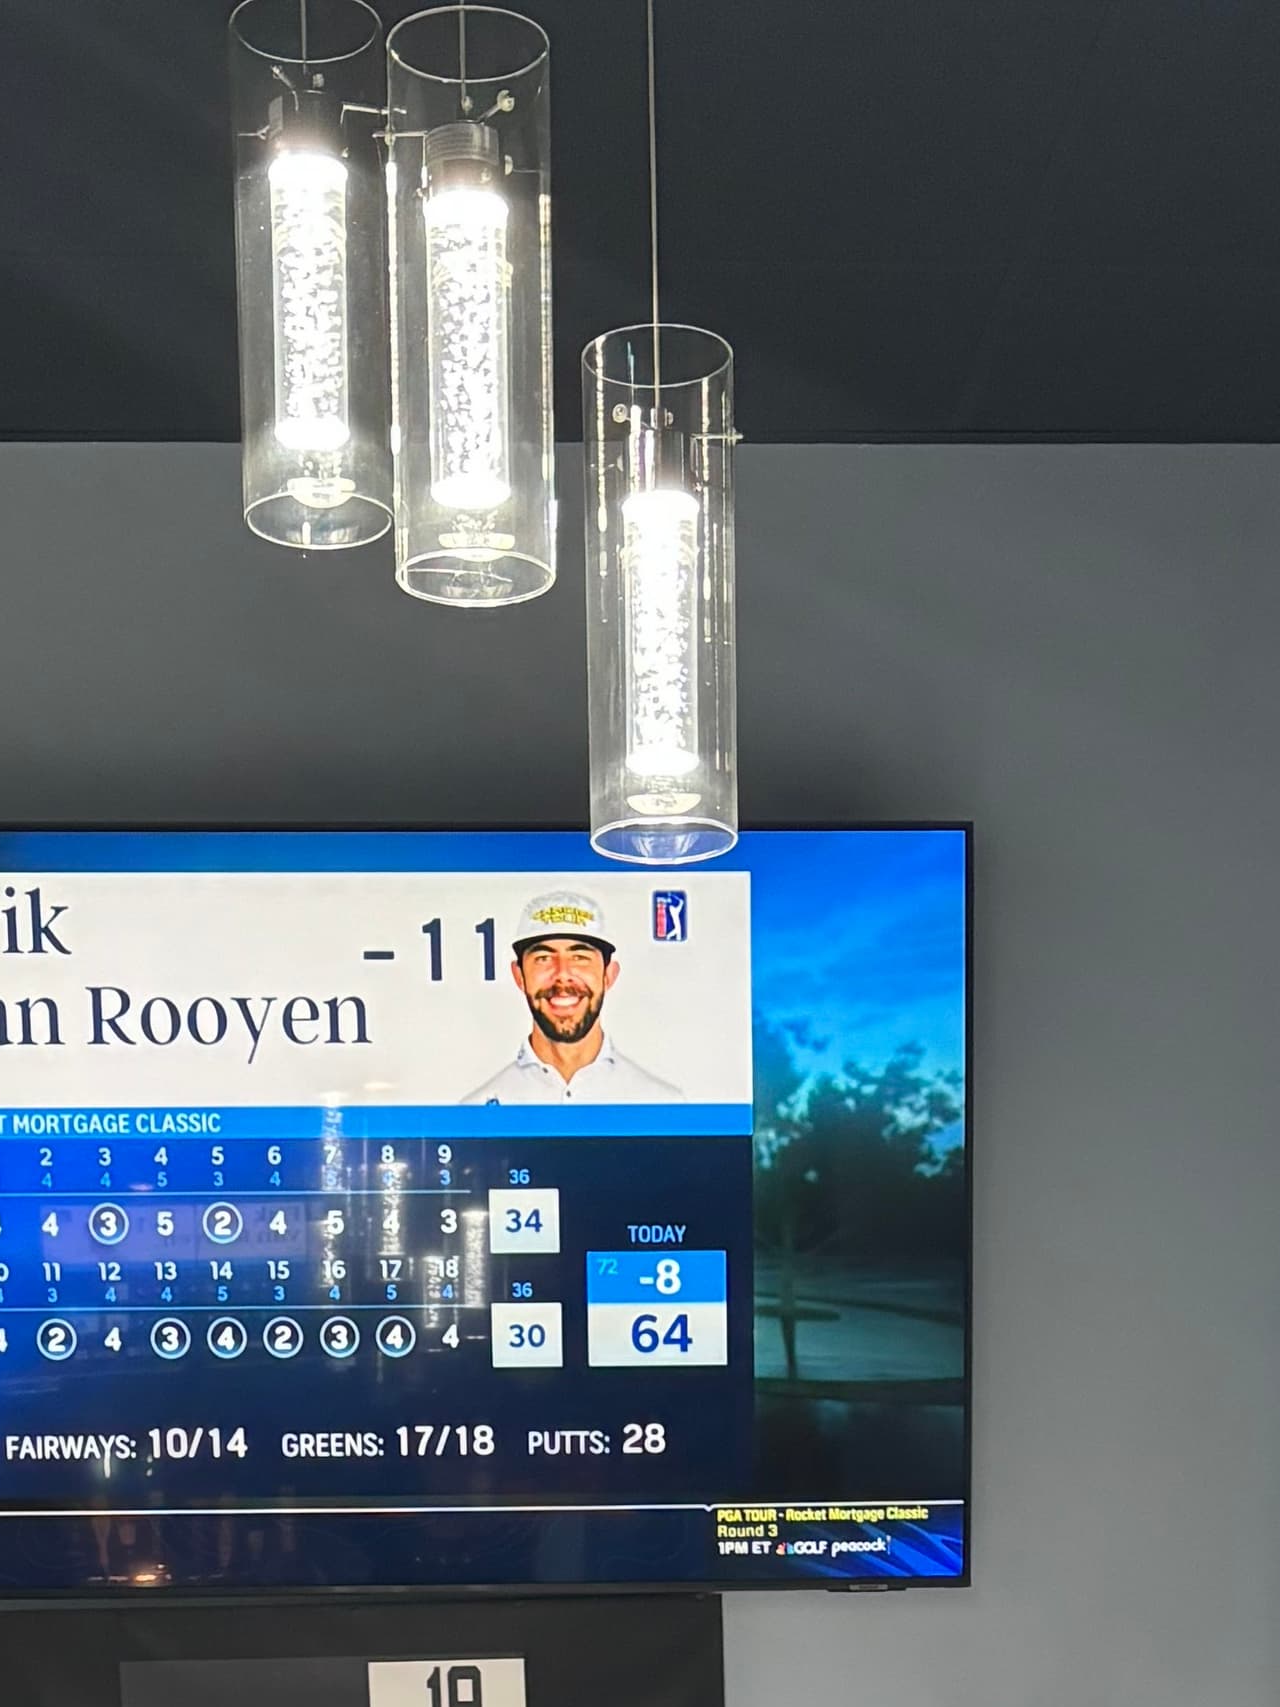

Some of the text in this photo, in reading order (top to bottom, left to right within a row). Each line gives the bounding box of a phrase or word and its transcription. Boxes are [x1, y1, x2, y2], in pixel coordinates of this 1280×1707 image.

[85, 986, 374, 1065] Rooyen
[13, 1113, 130, 1135] MORTGAGE
[136, 1112, 222, 1134] CLASSIC
[40, 1148, 53, 1167] 2
[98, 1147, 111, 1166] 3
[154, 1147, 168, 1166] 4
[211, 1146, 224, 1165] 5
[267, 1145, 281, 1165] 6
[323, 1145, 337, 1164] 7
[381, 1144, 395, 1163] 8
[437, 1144, 452, 1164] 9
[41, 1172, 52, 1188] 4
[100, 1172, 111, 1188] 4
[157, 1171, 168, 1187] 5
[214, 1171, 224, 1187] 3
[270, 1170, 281, 1186] 4
[440, 1169, 451, 1186] 3
[509, 1169, 531, 1185] 36
[41, 1212, 59, 1237] 4
[100, 1212, 117, 1237] 3
[157, 1211, 174, 1236] 5
[214, 1210, 232, 1236] 2
[270, 1210, 287, 1235] 4
[327, 1209, 345, 1235] 5
[383, 1210, 400, 1234] 4
[440, 1208, 457, 1233] 3
[505, 1208, 543, 1233] 34
[627, 1225, 687, 1243] TODAY
[42, 1262, 61, 1282] 11
[98, 1262, 121, 1281] 12
[154, 1261, 177, 1280] 13
[210, 1261, 233, 1280] 14
[267, 1260, 290, 1279] 15
[323, 1259, 346, 1279] 16
[379, 1259, 402, 1278] 17
[436, 1258, 459, 1278] 18
[597, 1258, 618, 1275] 72
[639, 1258, 682, 1295] -8
[48, 1287, 58, 1303] 3
[105, 1287, 117, 1302] 4
[161, 1286, 172, 1302] 4
[217, 1286, 228, 1302] 5
[274, 1285, 285, 1301] 3
[329, 1285, 340, 1301] 4
[386, 1284, 397, 1300] 5
[442, 1284, 453, 1299] 4
[512, 1282, 533, 1298] 36
[47, 1327, 66, 1352] 2
[104, 1327, 122, 1352] 4
[161, 1326, 179, 1351] 3
[217, 1326, 236, 1350] 4
[274, 1325, 293, 1350] 2
[330, 1324, 349, 1350] 3
[385, 1324, 404, 1349] 4
[441, 1324, 459, 1348] 4
[508, 1323, 546, 1348] 30
[631, 1313, 693, 1353] 64
[5, 1423, 666, 1461] FAIRWAYS: 10/14 GREENS: 17/18 PUTTS: 28
[717, 1509, 742, 1523] PGA
[744, 1508, 777, 1522] TOUR
[785, 1507, 827, 1521] Rocket
[828, 1506, 885, 1524] Mortgage
[886, 1505, 929, 1520] Classic
[717, 1523, 778, 1538] Round 3
[717, 1541, 772, 1555] 1PM ET
[794, 1541, 828, 1555] GOLF
